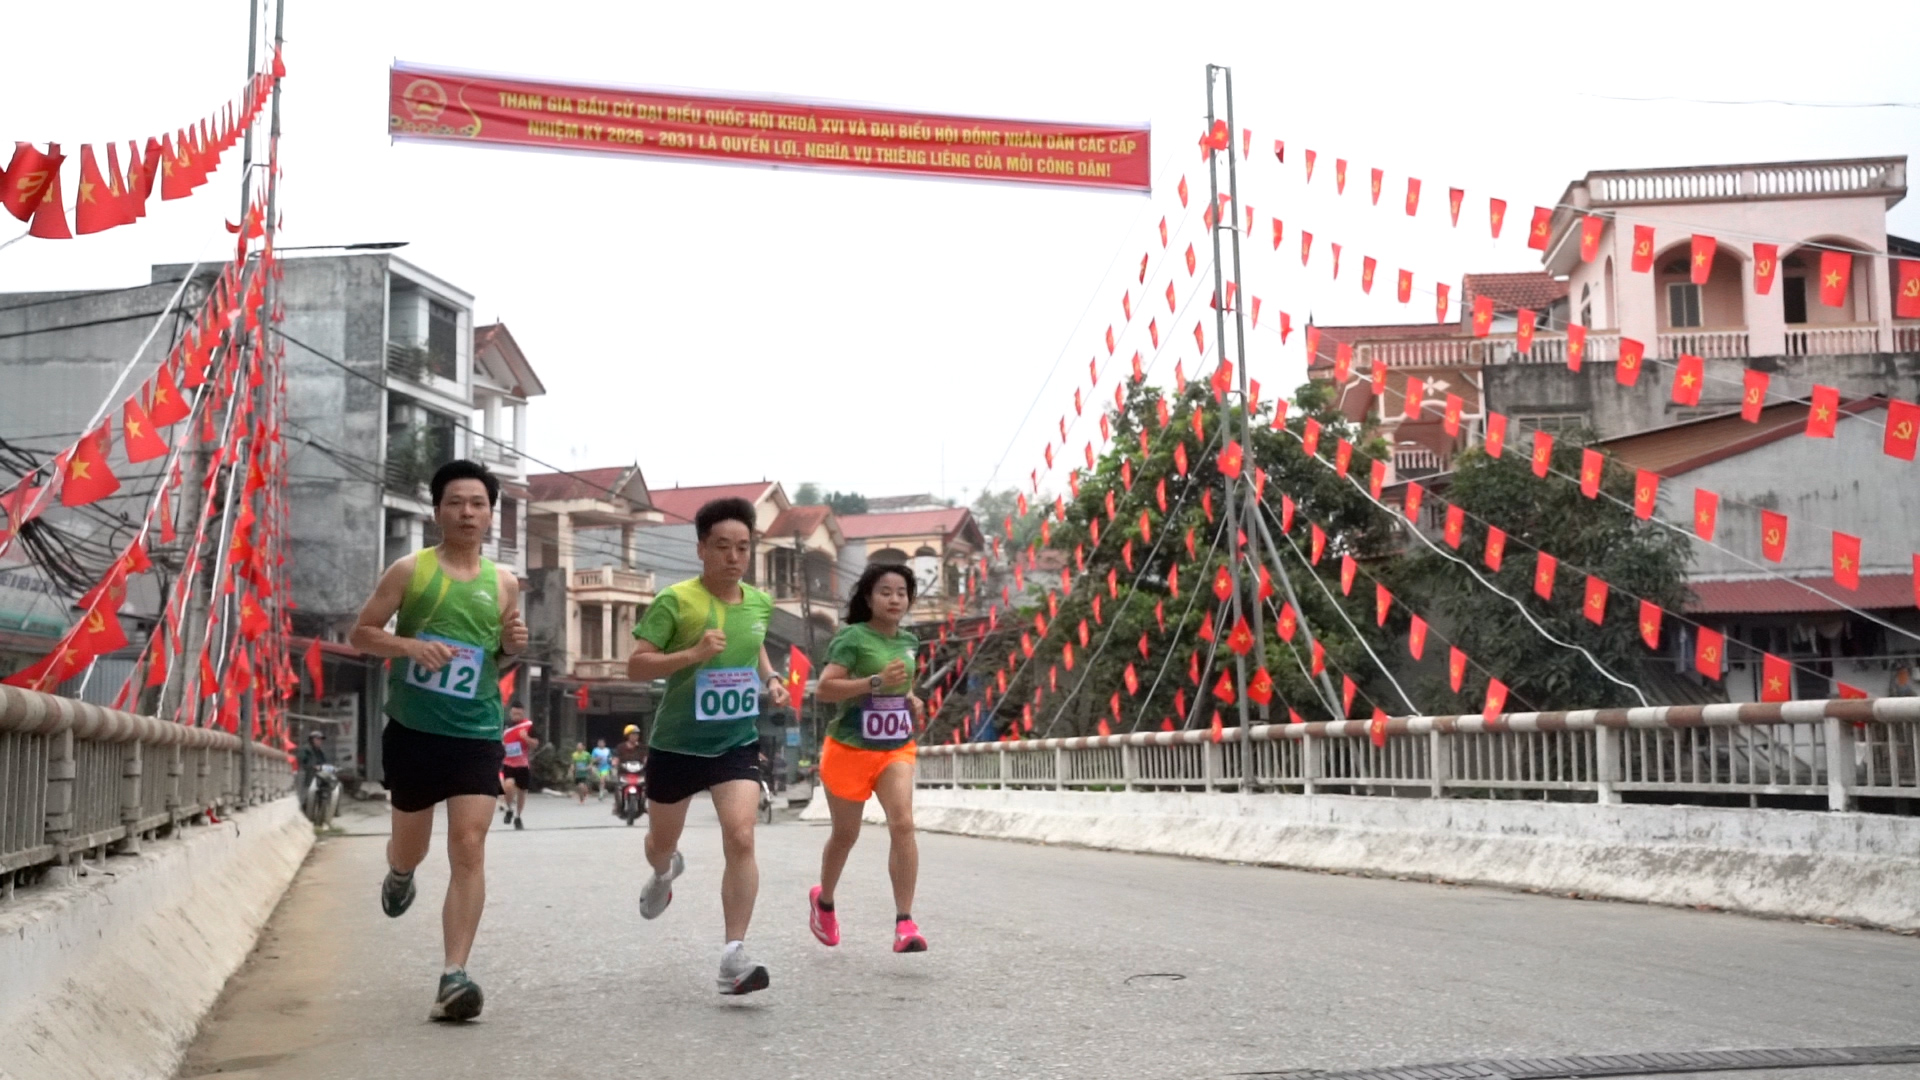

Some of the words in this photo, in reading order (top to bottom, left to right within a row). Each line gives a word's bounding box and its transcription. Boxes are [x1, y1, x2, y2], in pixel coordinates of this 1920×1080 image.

[499, 92, 542, 111] THAM
[547, 96, 573, 113] GIA
[705, 105, 745, 127] QUỐC
[749, 110, 773, 132] HỘI
[821, 117, 844, 135] XVI
[849, 117, 867, 137] VÀ
[870, 121, 894, 141] ĐẠI
[934, 125, 958, 146] HỘI
[1004, 131, 1043, 149] NHÂN
[1047, 132, 1075, 151] DÂN
[1078, 134, 1106, 153] CÁC
[1109, 135, 1137, 155] CẤP
[527, 119, 578, 141] NHIỆM
[607, 127, 644, 145] 2026
[659, 131, 693, 148] 2031
[699, 131, 717, 150] LÀ
[805, 141, 850, 161] NGHĨA
[854, 146, 872, 165] VỤ
[876, 145, 926, 165] THIÊNG
[930, 149, 971, 168] LIÊNG
[975, 150, 1002, 171] CỦA
[1037, 155, 1074, 175] CÔNG
[1078, 158, 1111, 178] DÂN!
[413, 663, 475, 694] 012
[700, 687, 756, 717] 006
[866, 712, 910, 737] 004
